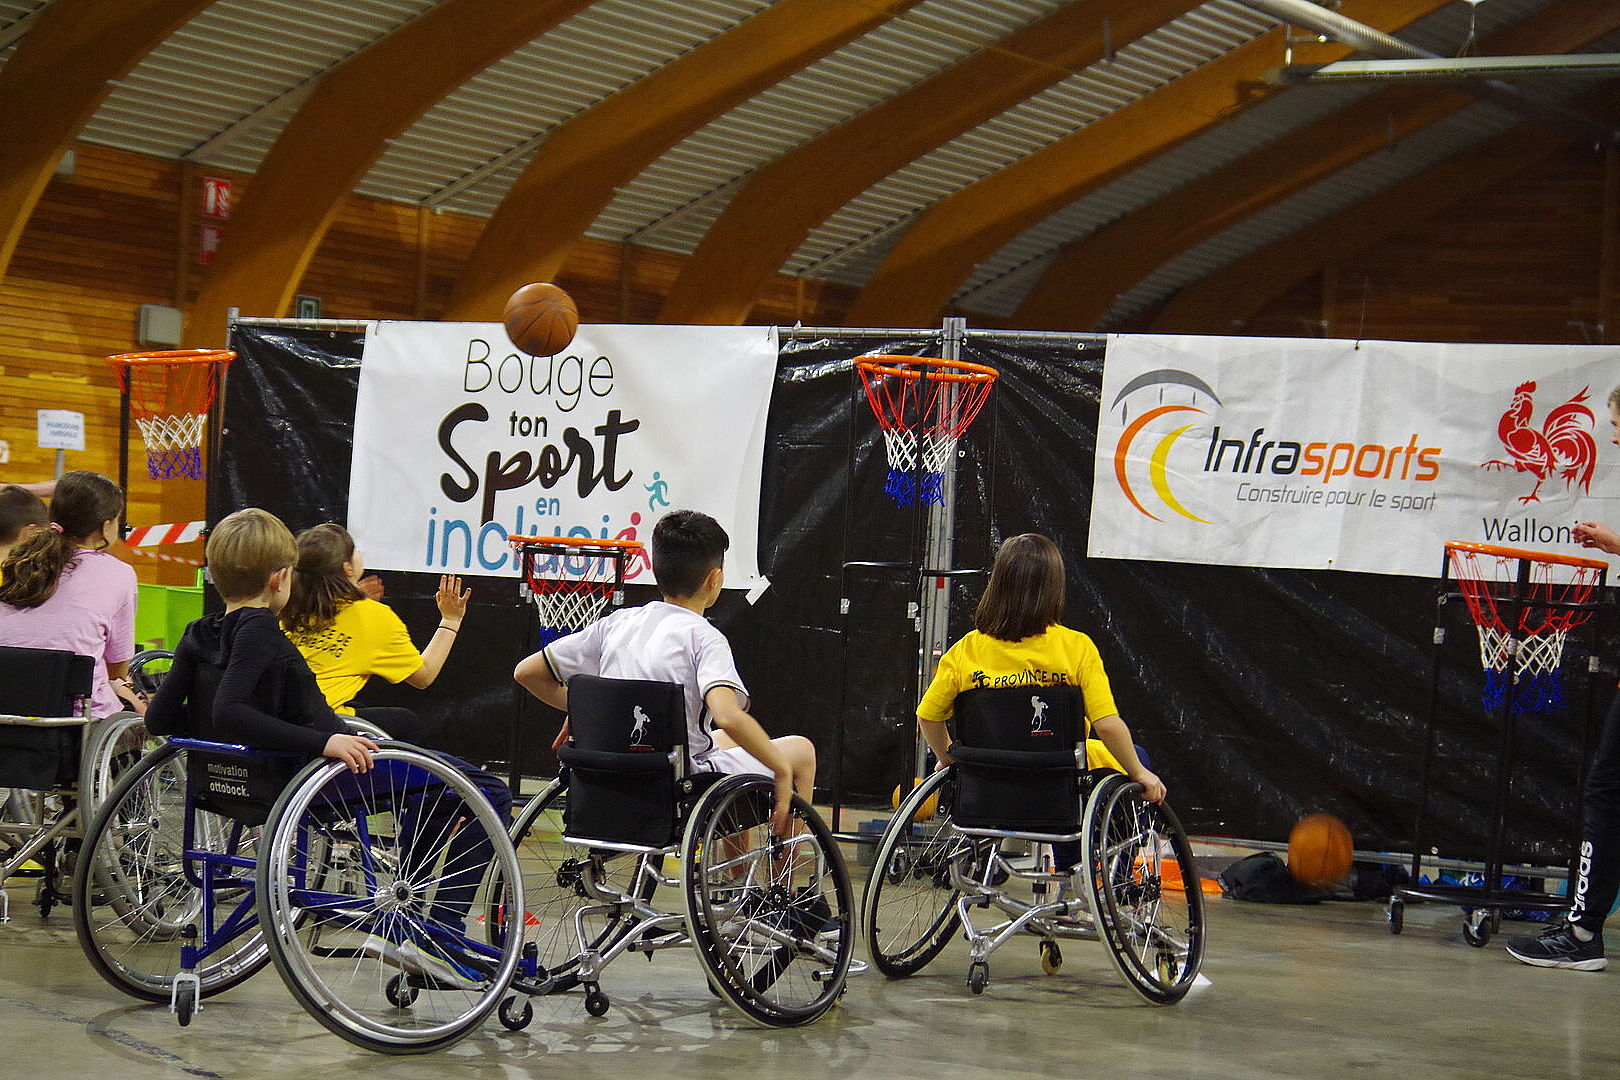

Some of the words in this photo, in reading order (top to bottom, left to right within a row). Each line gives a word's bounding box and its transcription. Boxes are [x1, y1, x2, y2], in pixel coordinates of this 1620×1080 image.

[464, 338, 614, 412] Bouge
[509, 411, 548, 437] ton
[438, 402, 640, 527] Sport
[1204, 426, 1442, 484] Infrasports
[535, 497, 560, 516] en
[1236, 482, 1323, 504] Construire
[1325, 491, 1366, 508] pour
[1369, 489, 1385, 508] le
[1391, 492, 1437, 512] sport
[994, 669, 1048, 687] PROVINCE
[207, 763, 248, 778] motivation
